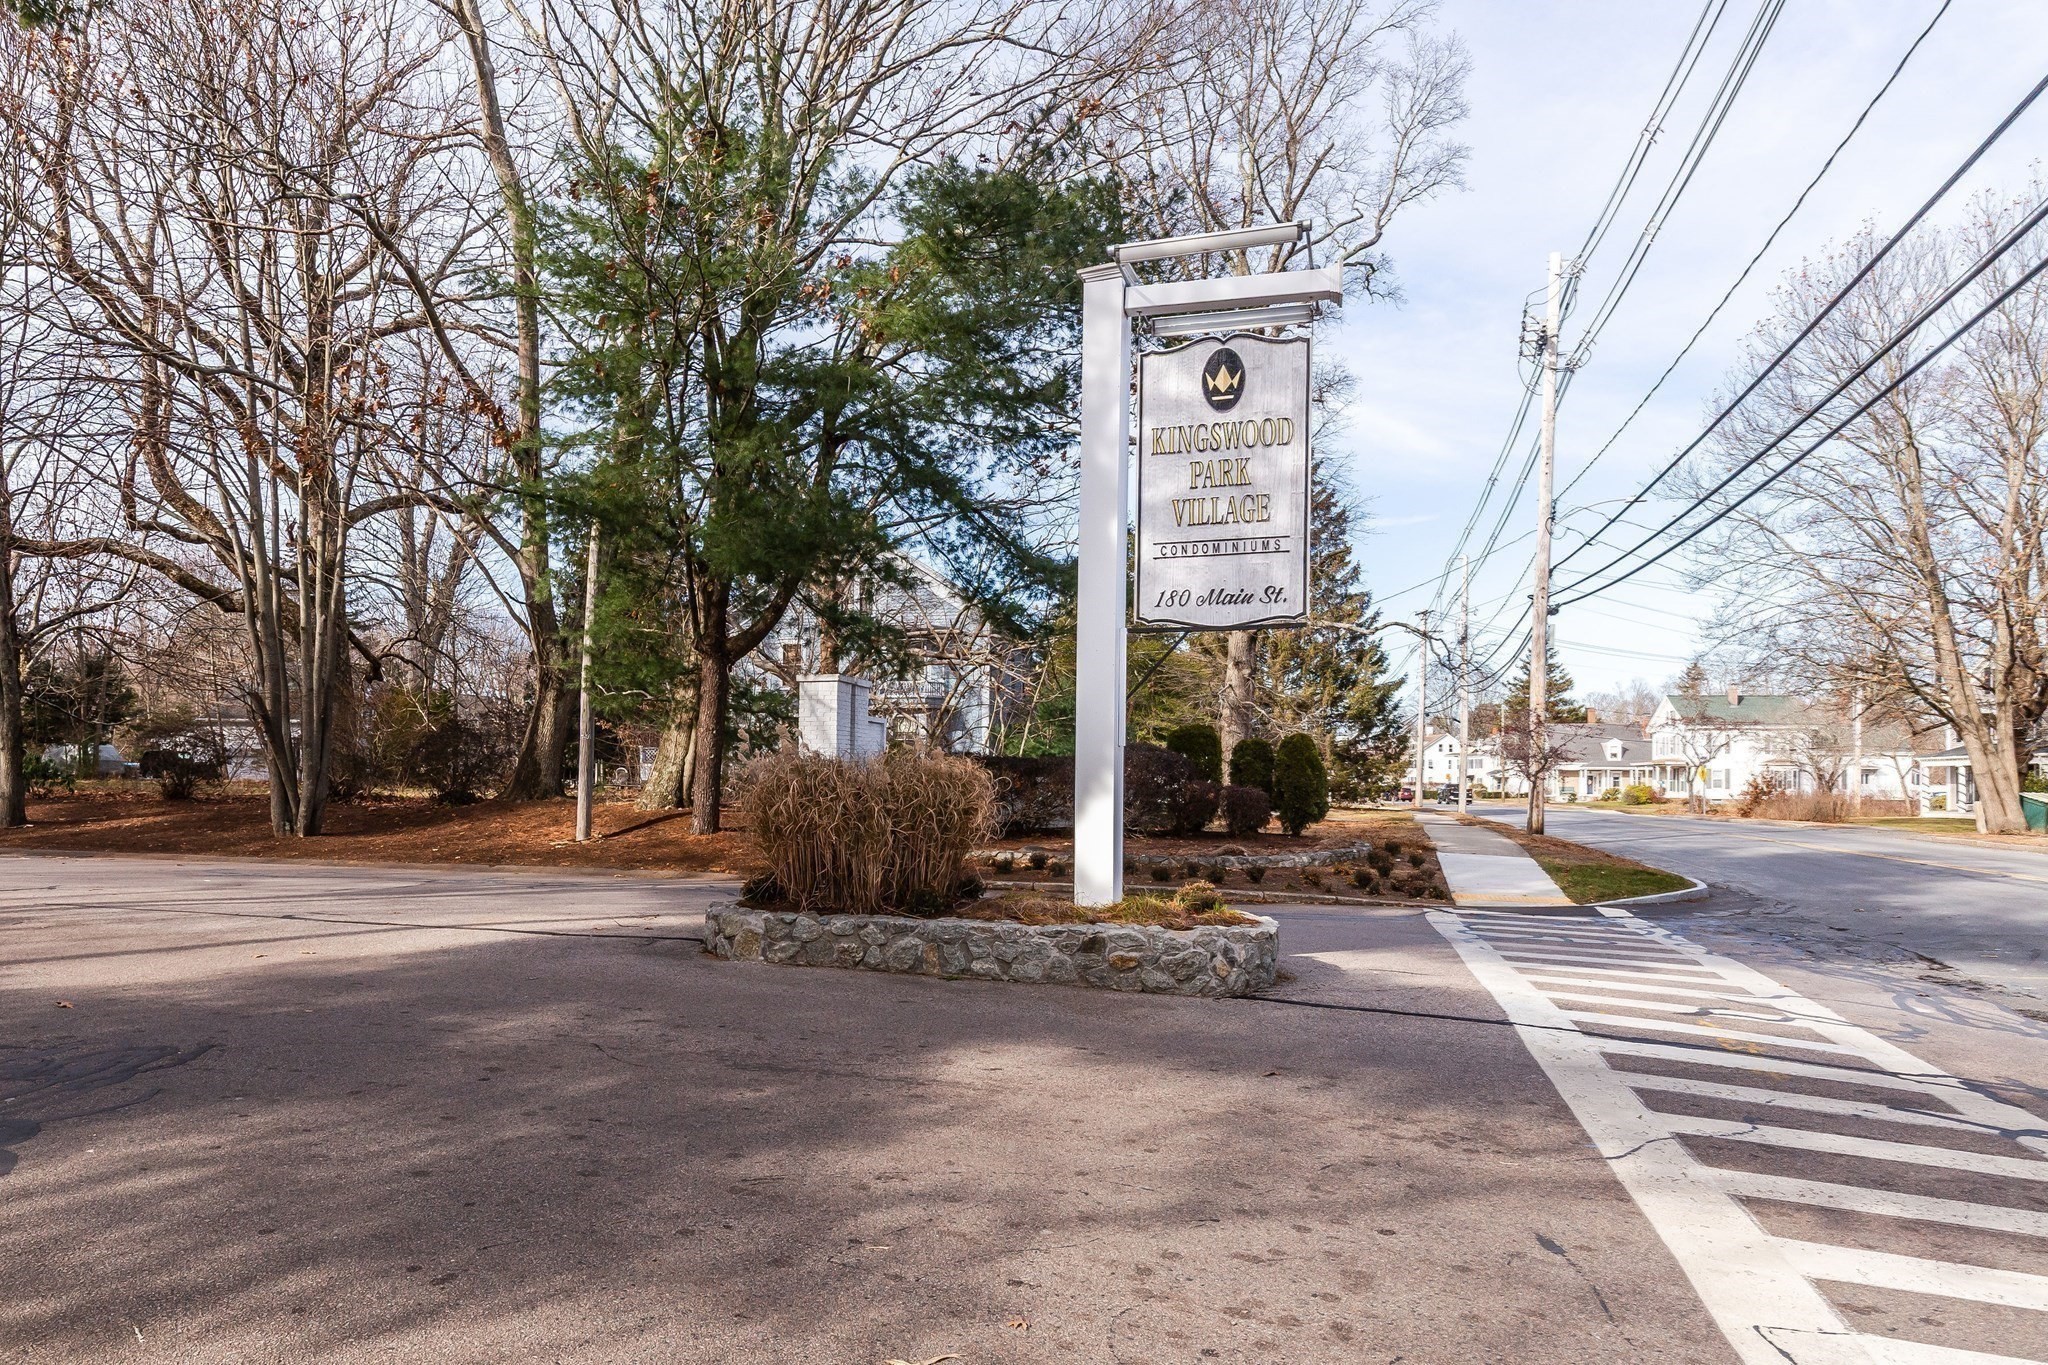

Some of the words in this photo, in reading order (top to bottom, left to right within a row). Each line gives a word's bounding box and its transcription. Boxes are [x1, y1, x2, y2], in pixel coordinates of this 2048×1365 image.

[1151, 417, 1294, 456] KINGSWOOD
[1189, 457, 1251, 489] PARK
[1172, 493, 1271, 527] VILLAGE
[1160, 539, 1281, 556] CONDOMINIUMS
[1154, 589, 1190, 608] 180
[1196, 587, 1254, 607] Main
[1259, 585, 1287, 606] St.
